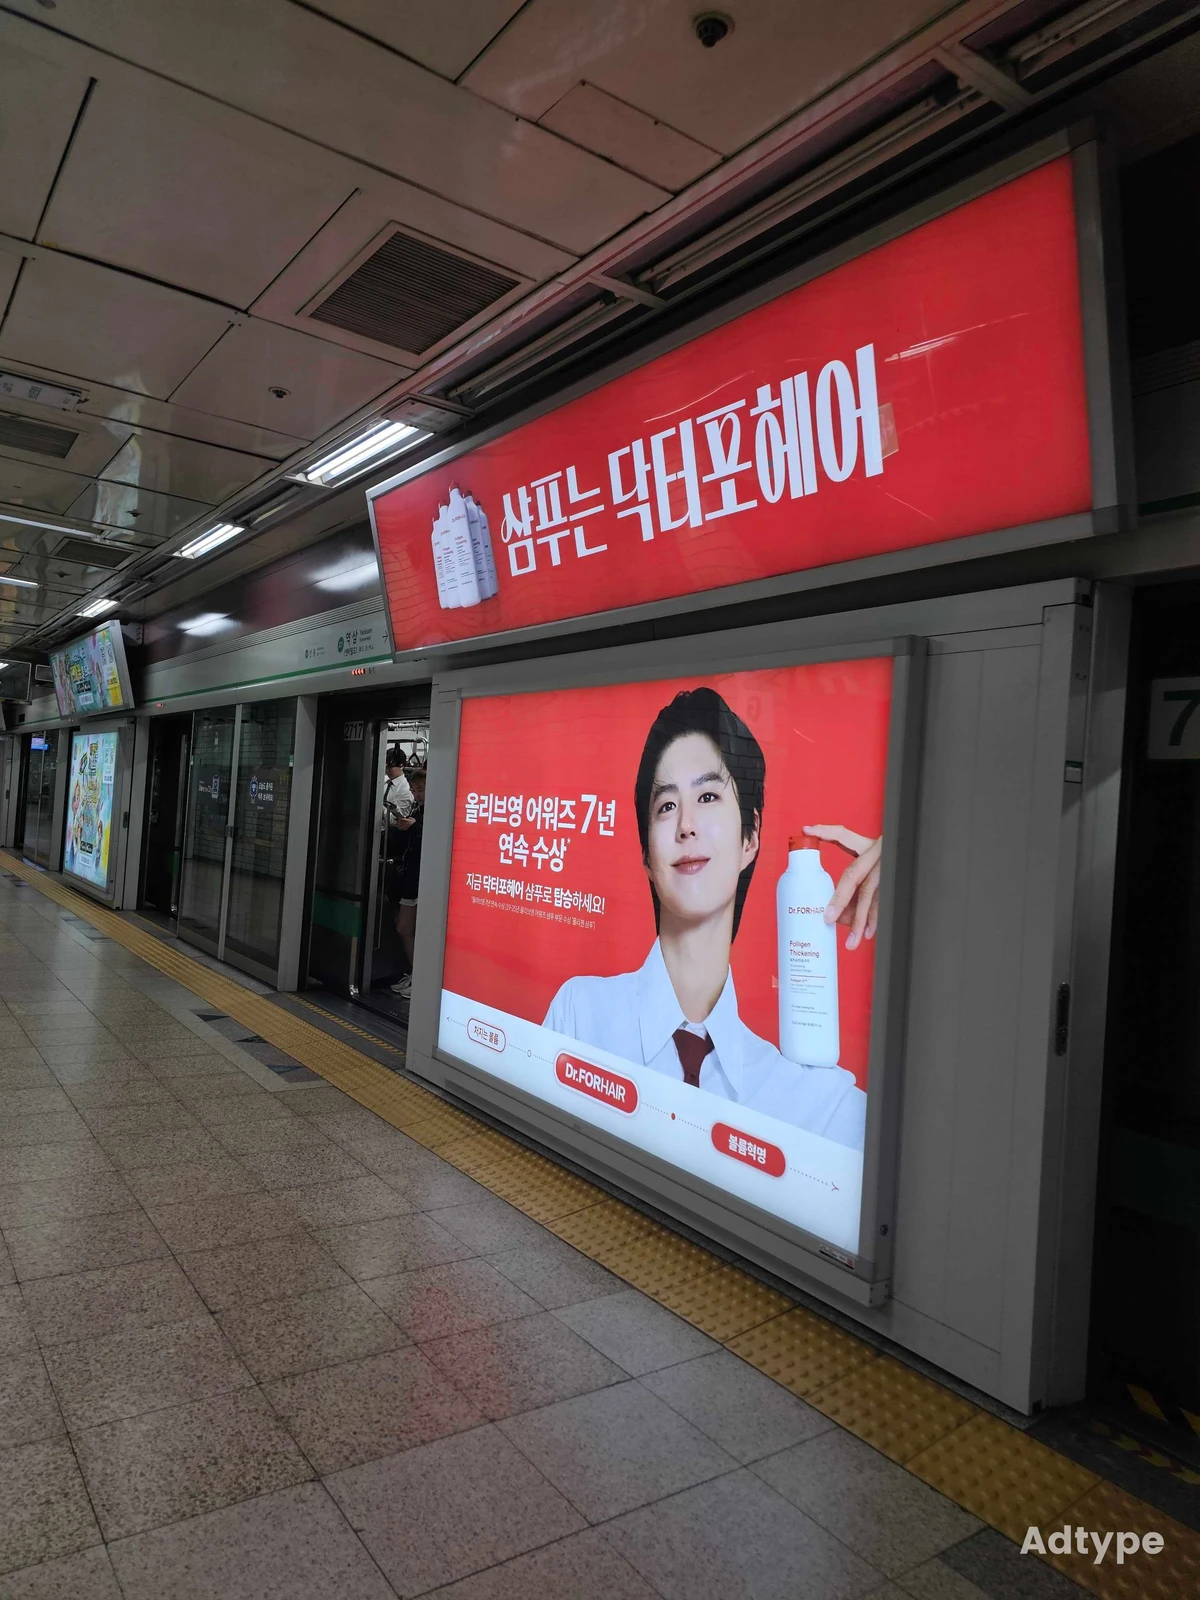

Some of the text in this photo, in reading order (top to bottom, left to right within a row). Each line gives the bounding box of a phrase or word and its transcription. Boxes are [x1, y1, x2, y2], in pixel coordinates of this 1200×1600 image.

[501, 343, 884, 577] 샴푸는 닥터포헤어
[344, 722, 364, 739] 2717
[1164, 689, 1200, 746] 7
[465, 792, 616, 837] 올리브영 어워즈 7년
[498, 832, 529, 868] 연속
[466, 873, 605, 915] 지금 닥터포헤어 샴푸로 탑승하세요!
[789, 940, 811, 949] Folligen
[789, 949, 820, 959] Thickening
[565, 1062, 626, 1103] Dr.FORHAIR
[728, 1133, 767, 1165] 볼륨혁명
